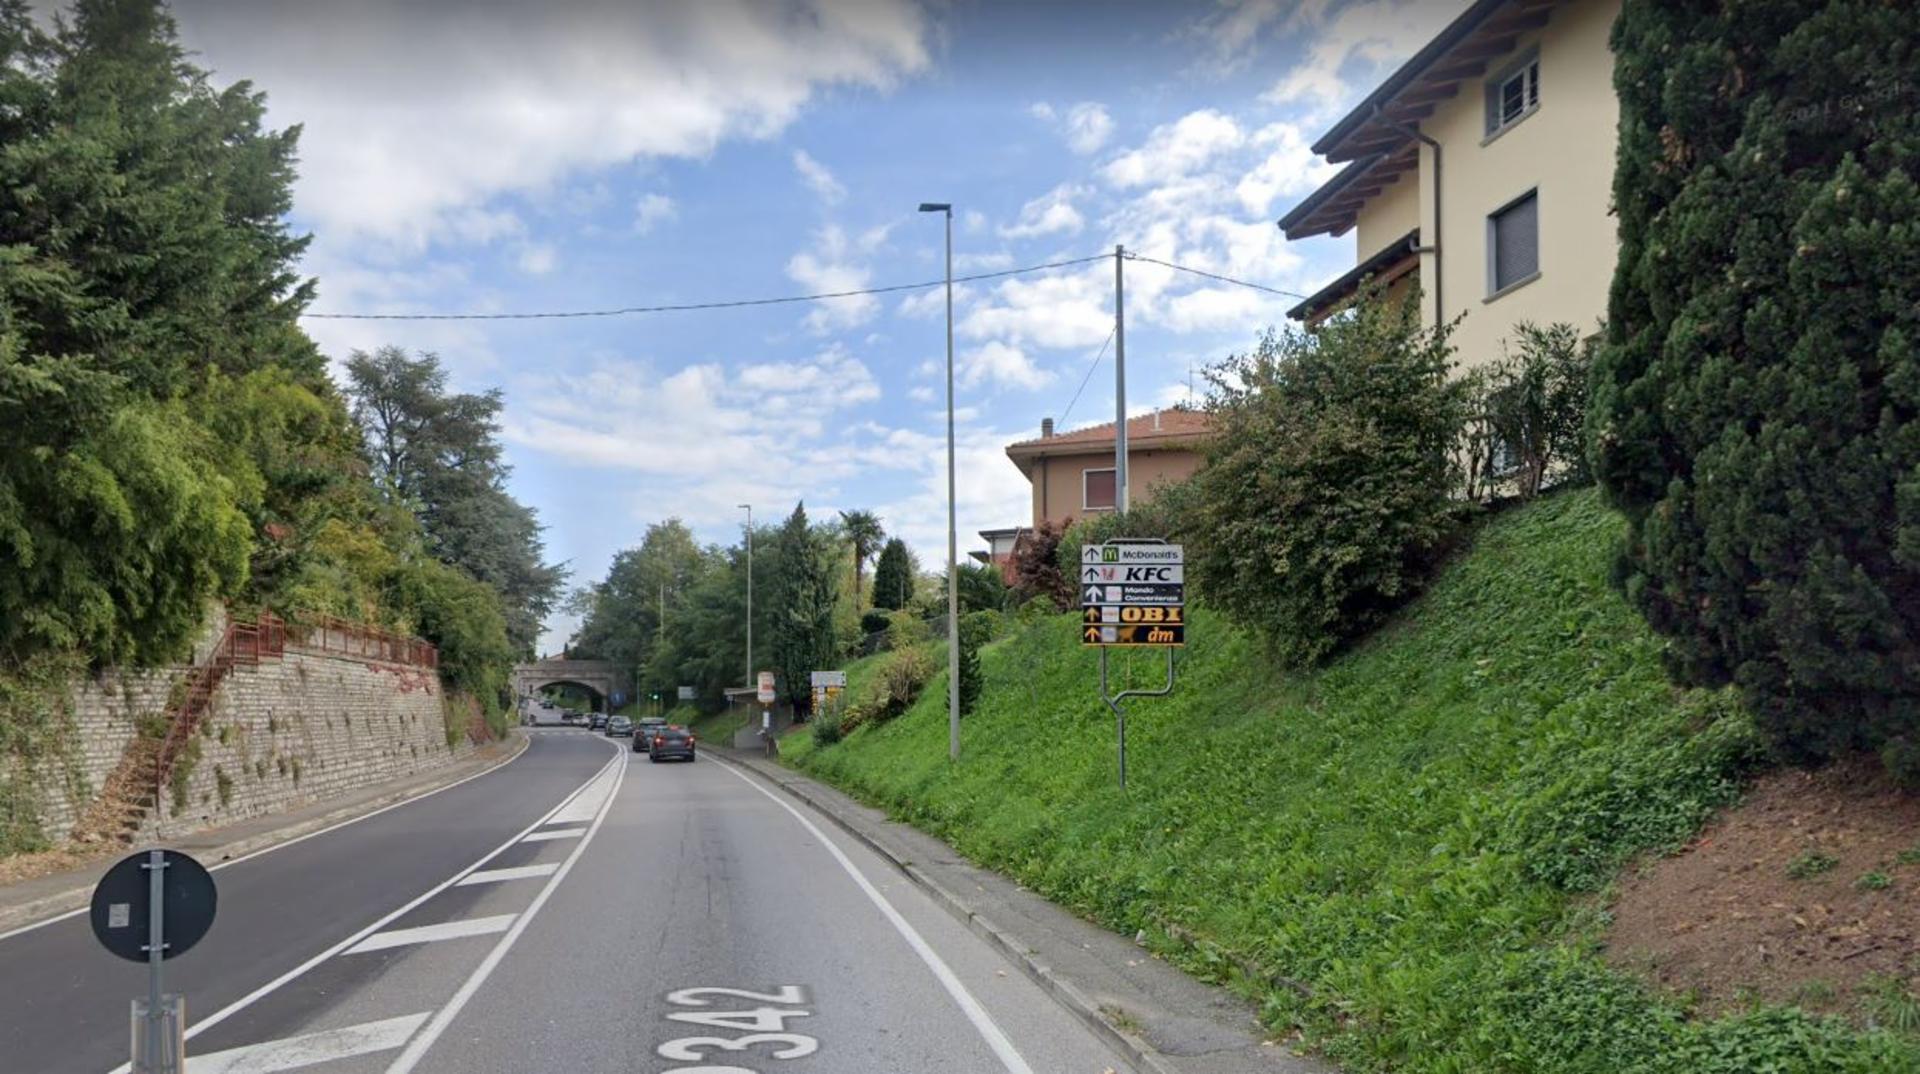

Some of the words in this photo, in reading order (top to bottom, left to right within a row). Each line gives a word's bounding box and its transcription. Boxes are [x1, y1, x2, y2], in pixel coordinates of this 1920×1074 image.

[1123, 551, 1178, 559] McDonald's
[1125, 567, 1171, 581] KFC
[1121, 607, 1181, 622] OBI
[1147, 626, 1174, 642] dm
